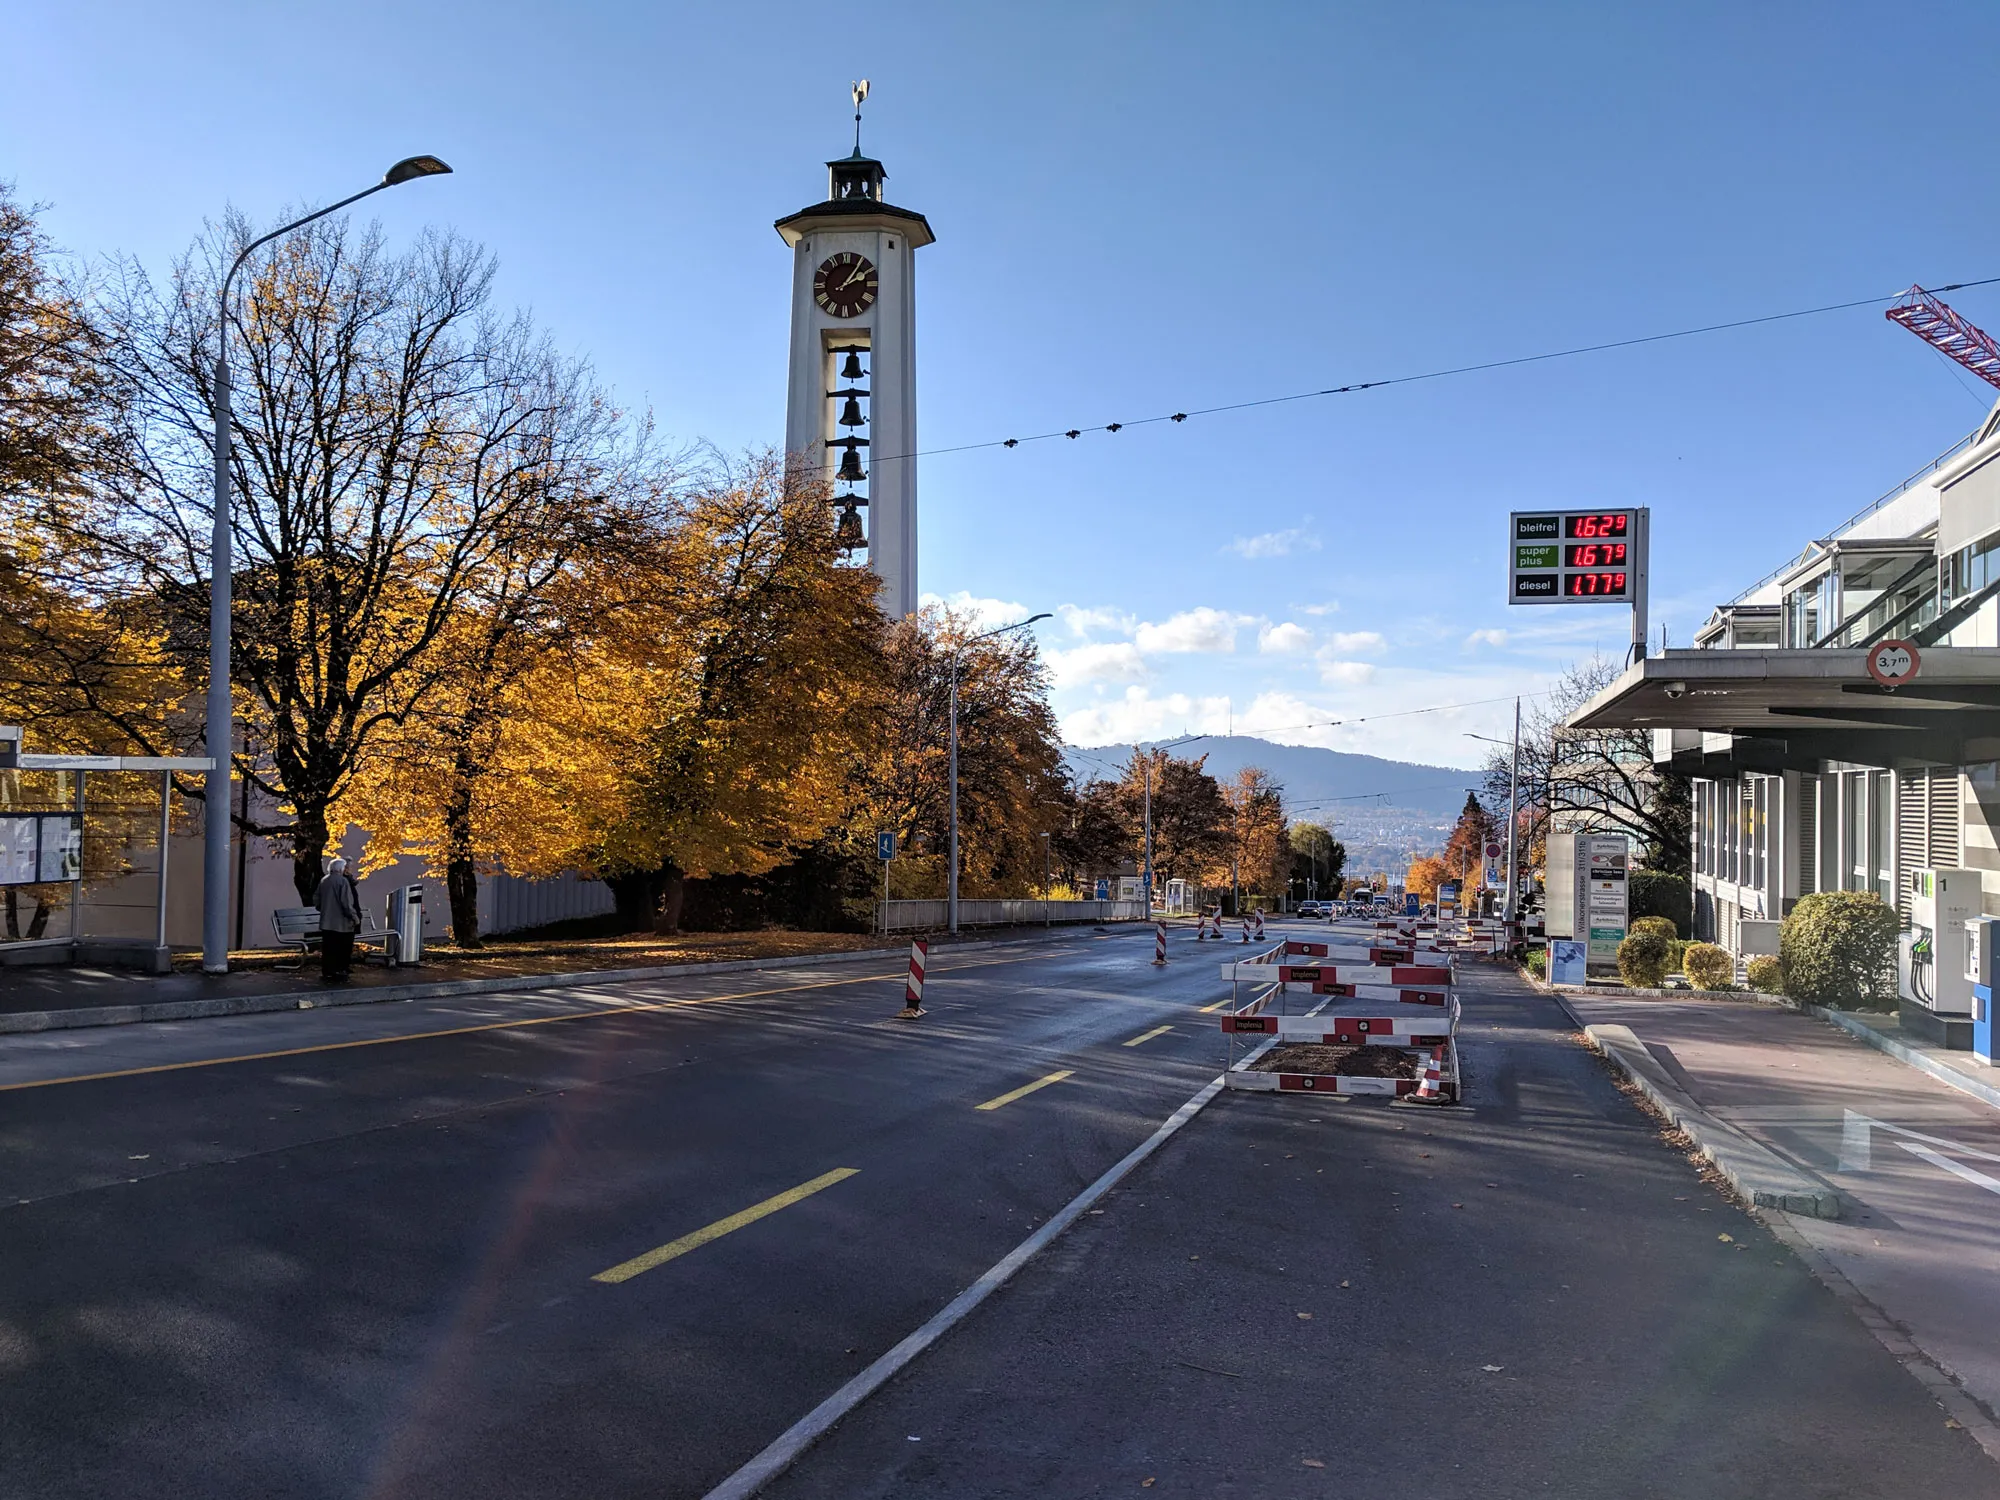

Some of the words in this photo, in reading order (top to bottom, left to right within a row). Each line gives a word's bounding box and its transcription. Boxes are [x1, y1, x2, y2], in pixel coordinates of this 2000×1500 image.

[1519, 522, 1556, 533] bleifrei
[1519, 546, 1551, 556] super
[1519, 556, 1543, 567] plus
[1519, 580, 1551, 590] diesel
[1578, 840, 1586, 872] 311/311b
[1939, 878, 1947, 892] 1
[1292, 970, 1319, 979] Implenia
[1236, 1020, 1263, 1029] Implenia
